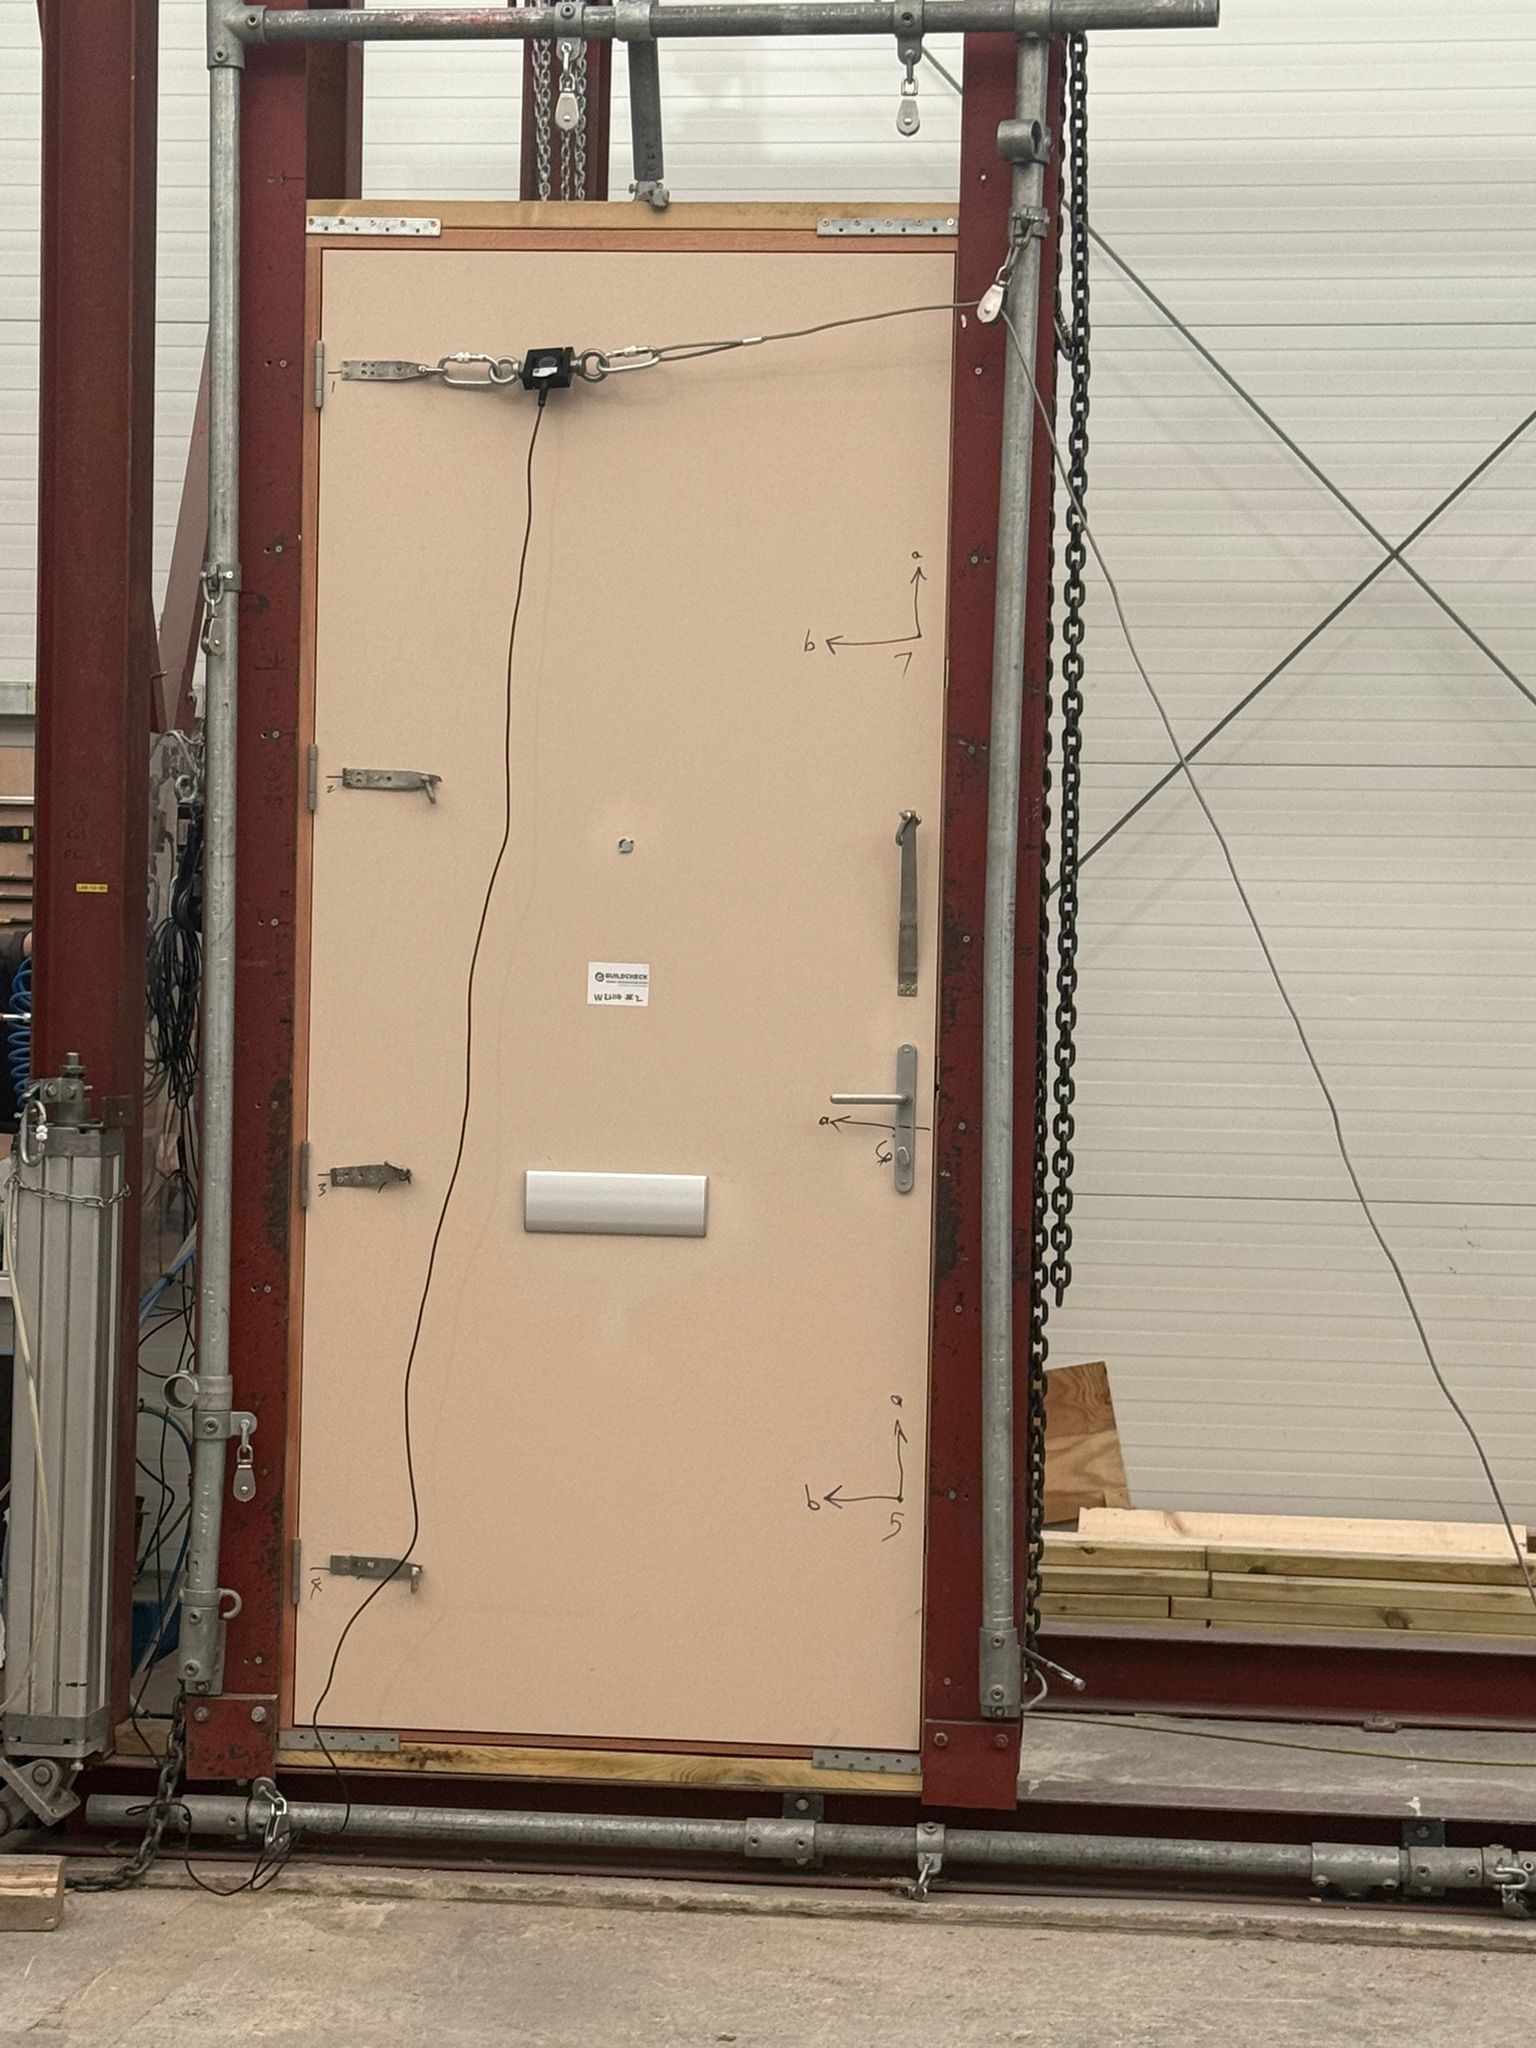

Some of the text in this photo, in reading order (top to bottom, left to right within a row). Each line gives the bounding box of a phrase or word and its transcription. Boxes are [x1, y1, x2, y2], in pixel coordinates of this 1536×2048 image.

[911, 550, 923, 560] a
[804, 628, 816, 653] b
[893, 651, 913, 680] 7
[818, 1116, 830, 1126] a
[317, 1182, 327, 1197] 3
[890, 1395, 903, 1408] a
[881, 1511, 905, 1543] 5
